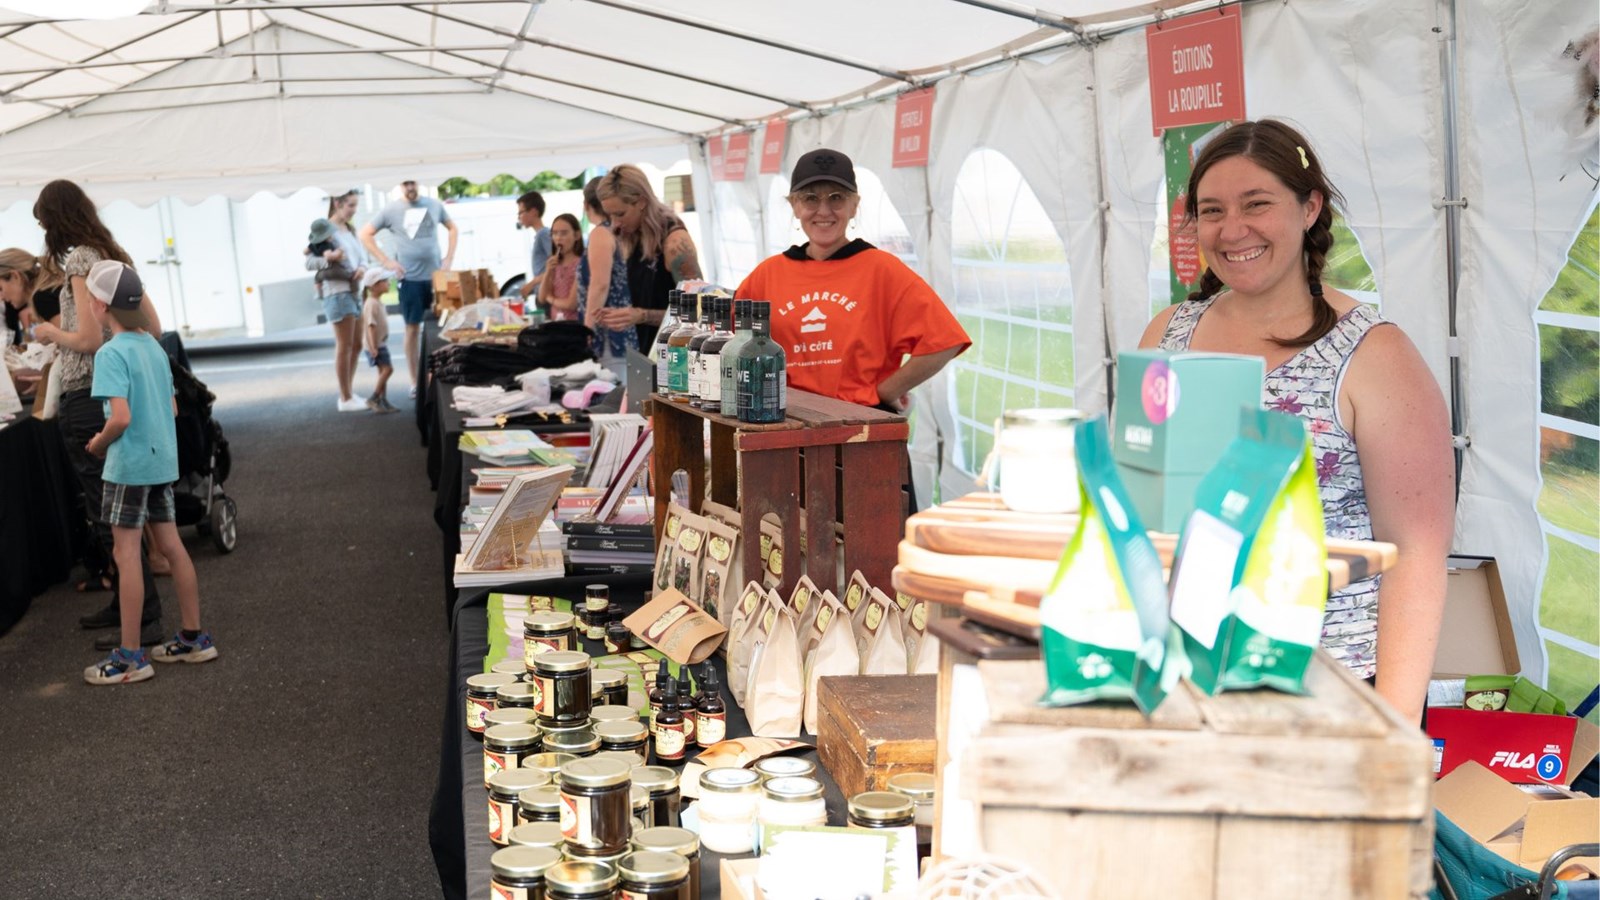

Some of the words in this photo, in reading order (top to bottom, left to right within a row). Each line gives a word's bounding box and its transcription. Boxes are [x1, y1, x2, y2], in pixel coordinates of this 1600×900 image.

[1172, 43, 1213, 74] ÉDITIONS
[1168, 88, 1180, 113] LA
[1180, 82, 1223, 111] ROUPILLE
[778, 301, 795, 316] LE
[801, 291, 857, 312] MARCHÉ
[809, 339, 833, 352] CÔTÉ
[1489, 751, 1536, 769] FILA
[1544, 760, 1554, 773] 9
